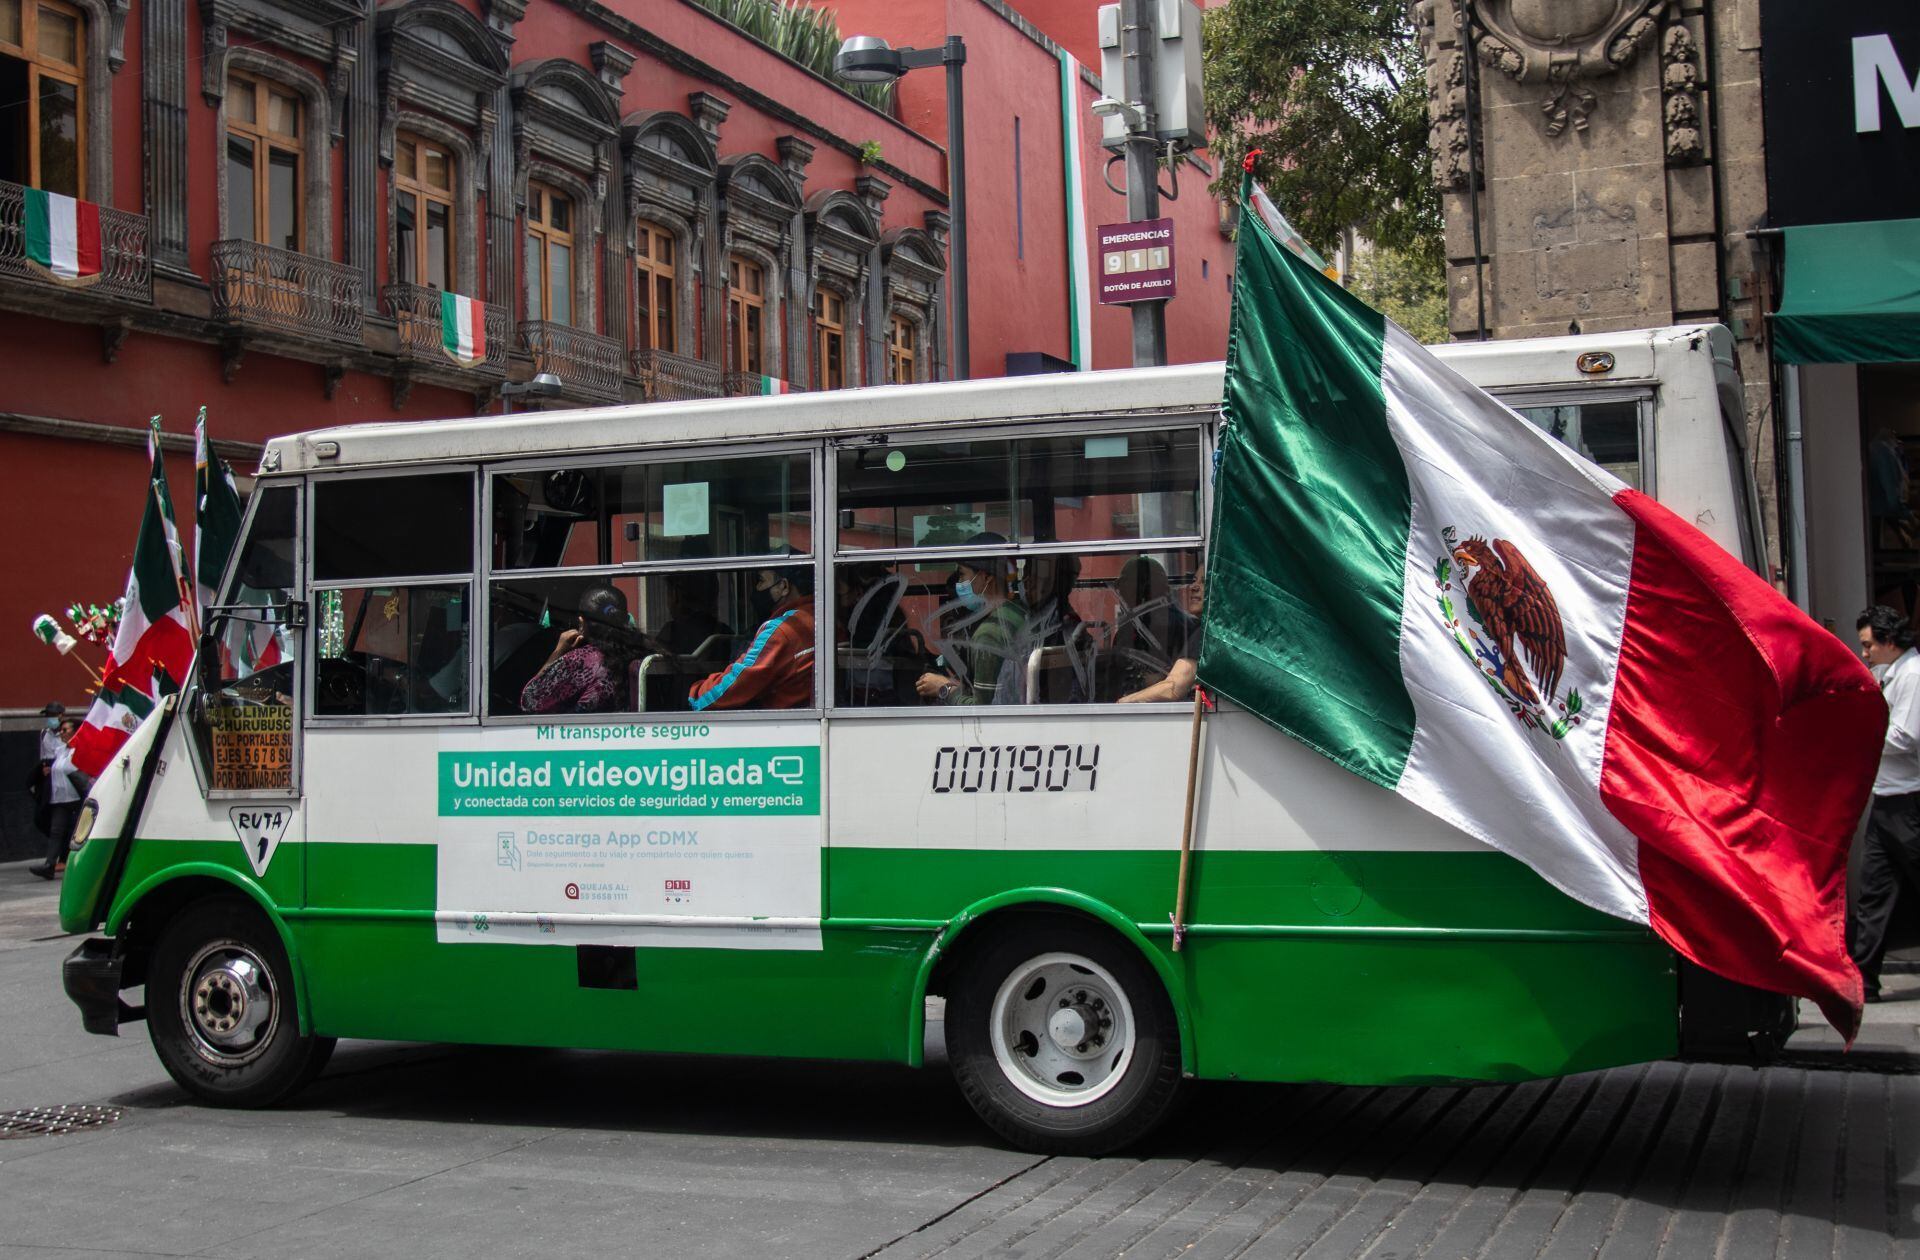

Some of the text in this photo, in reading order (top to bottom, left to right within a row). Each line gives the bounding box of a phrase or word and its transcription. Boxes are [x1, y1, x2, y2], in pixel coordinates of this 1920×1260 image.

[1102, 229, 1170, 244] EMERGENCIAS
[1108, 249, 1163, 272] 911
[1104, 279, 1172, 293] BOTÓN DE AUXILIO
[237, 733, 280, 747] PORTALES
[537, 725, 710, 741] Mi transporte seguro
[216, 748, 242, 763] EJES
[244, 748, 251, 763] 5
[253, 748, 260, 763] 6
[261, 748, 268, 763] 7
[269, 748, 276, 763] 8
[453, 758, 763, 792] Unidad videovigilada
[932, 744, 1100, 793] 0011904
[216, 771, 234, 788] POR
[453, 793, 804, 810] y conectada con servicios de seguridad y emergencia
[239, 812, 282, 830] RUTA
[526, 831, 699, 848] Descarga App CDMX
[257, 836, 269, 864] 1
[544, 850, 591, 860] seguimiento
[599, 850, 608, 858] tu
[609, 850, 628, 859] viaje
[700, 850, 723, 860] quien
[580, 883, 613, 891] QUEJAS
[666, 881, 689, 890] 911
